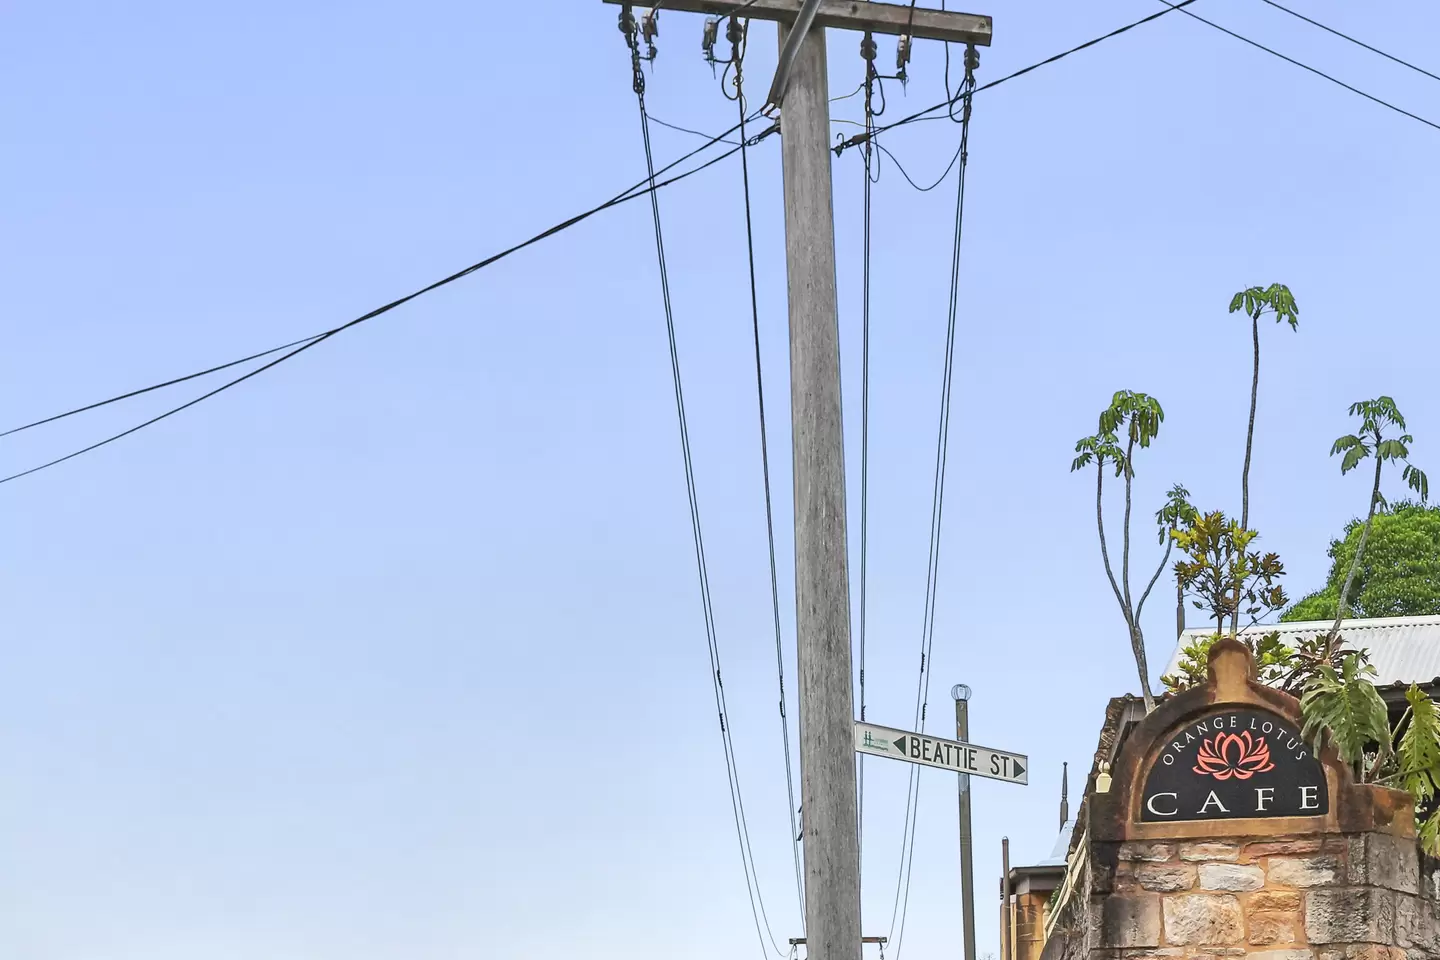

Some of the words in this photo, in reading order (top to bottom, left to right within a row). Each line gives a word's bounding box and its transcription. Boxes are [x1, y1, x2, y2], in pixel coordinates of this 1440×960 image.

[910, 736, 978, 771] BEATTIE
[990, 753, 1010, 778] ST
[1163, 716, 1237, 766] ORANGE
[1250, 717, 1307, 761] LOTUS
[1147, 785, 1320, 816] CAFE
